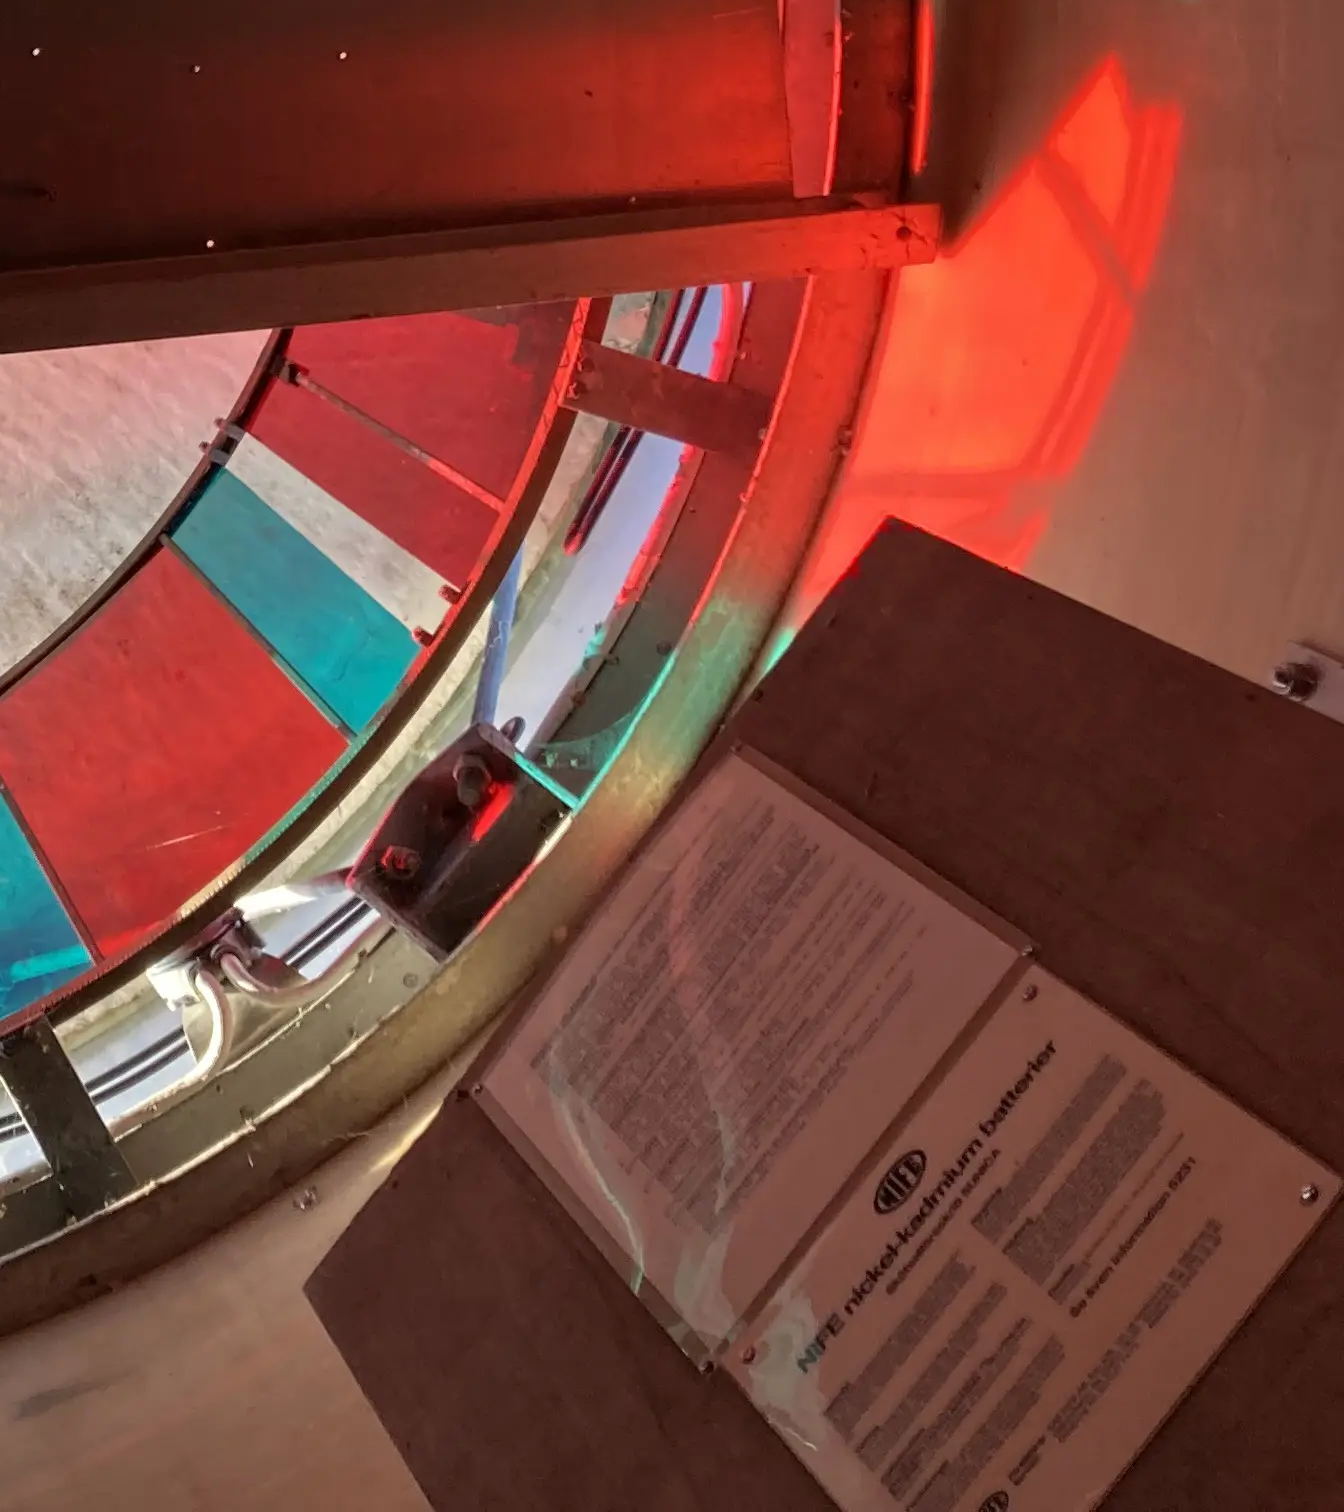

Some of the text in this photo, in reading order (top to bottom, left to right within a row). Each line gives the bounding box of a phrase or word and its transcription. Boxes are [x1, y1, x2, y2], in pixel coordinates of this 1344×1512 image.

[792, 1310, 849, 1375] NIFE
[838, 1133, 987, 1317] nickel-kadmium
[977, 1037, 1062, 1139] batterier
